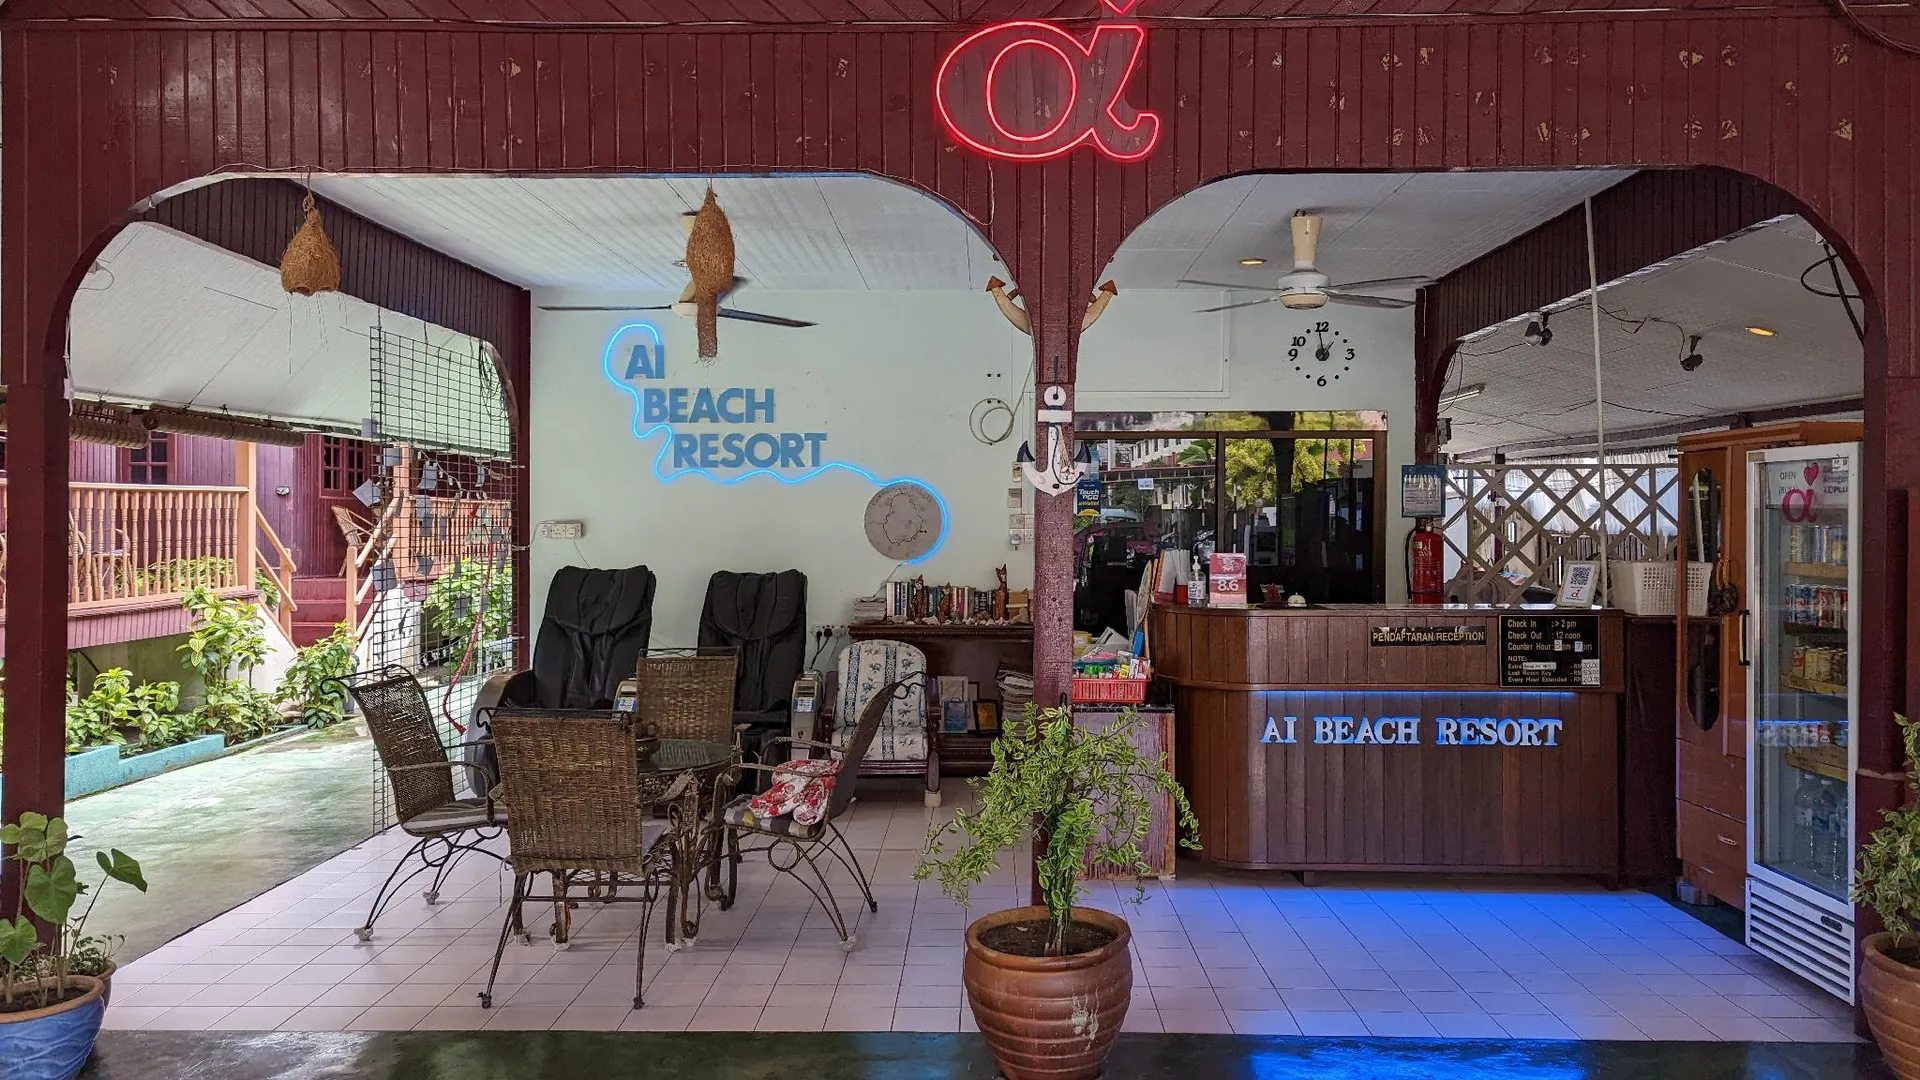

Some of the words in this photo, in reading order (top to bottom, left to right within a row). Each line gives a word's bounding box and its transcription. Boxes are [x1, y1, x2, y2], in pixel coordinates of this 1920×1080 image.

[1315, 321, 1329, 333] 12
[1291, 336, 1306, 347] 10
[1288, 348, 1298, 361] 9
[1345, 348, 1355, 361] 3
[625, 344, 665, 379] AI
[1316, 375, 1327, 387] 6
[643, 387, 774, 423] BEACH
[673, 432, 827, 468] RESORT
[1217, 579, 1240, 592] 8.6
[1507, 619, 1528, 628] Check
[1530, 619, 1537, 628] In
[1507, 631, 1528, 640] Check
[1530, 631, 1542, 640] Out
[1556, 631, 1564, 640] 12
[1565, 632, 1581, 640] noon
[1507, 642, 1533, 651] Counter
[1260, 716, 1298, 745] AI
[1313, 716, 1421, 746] BEACH
[1435, 716, 1564, 747] RESORT
